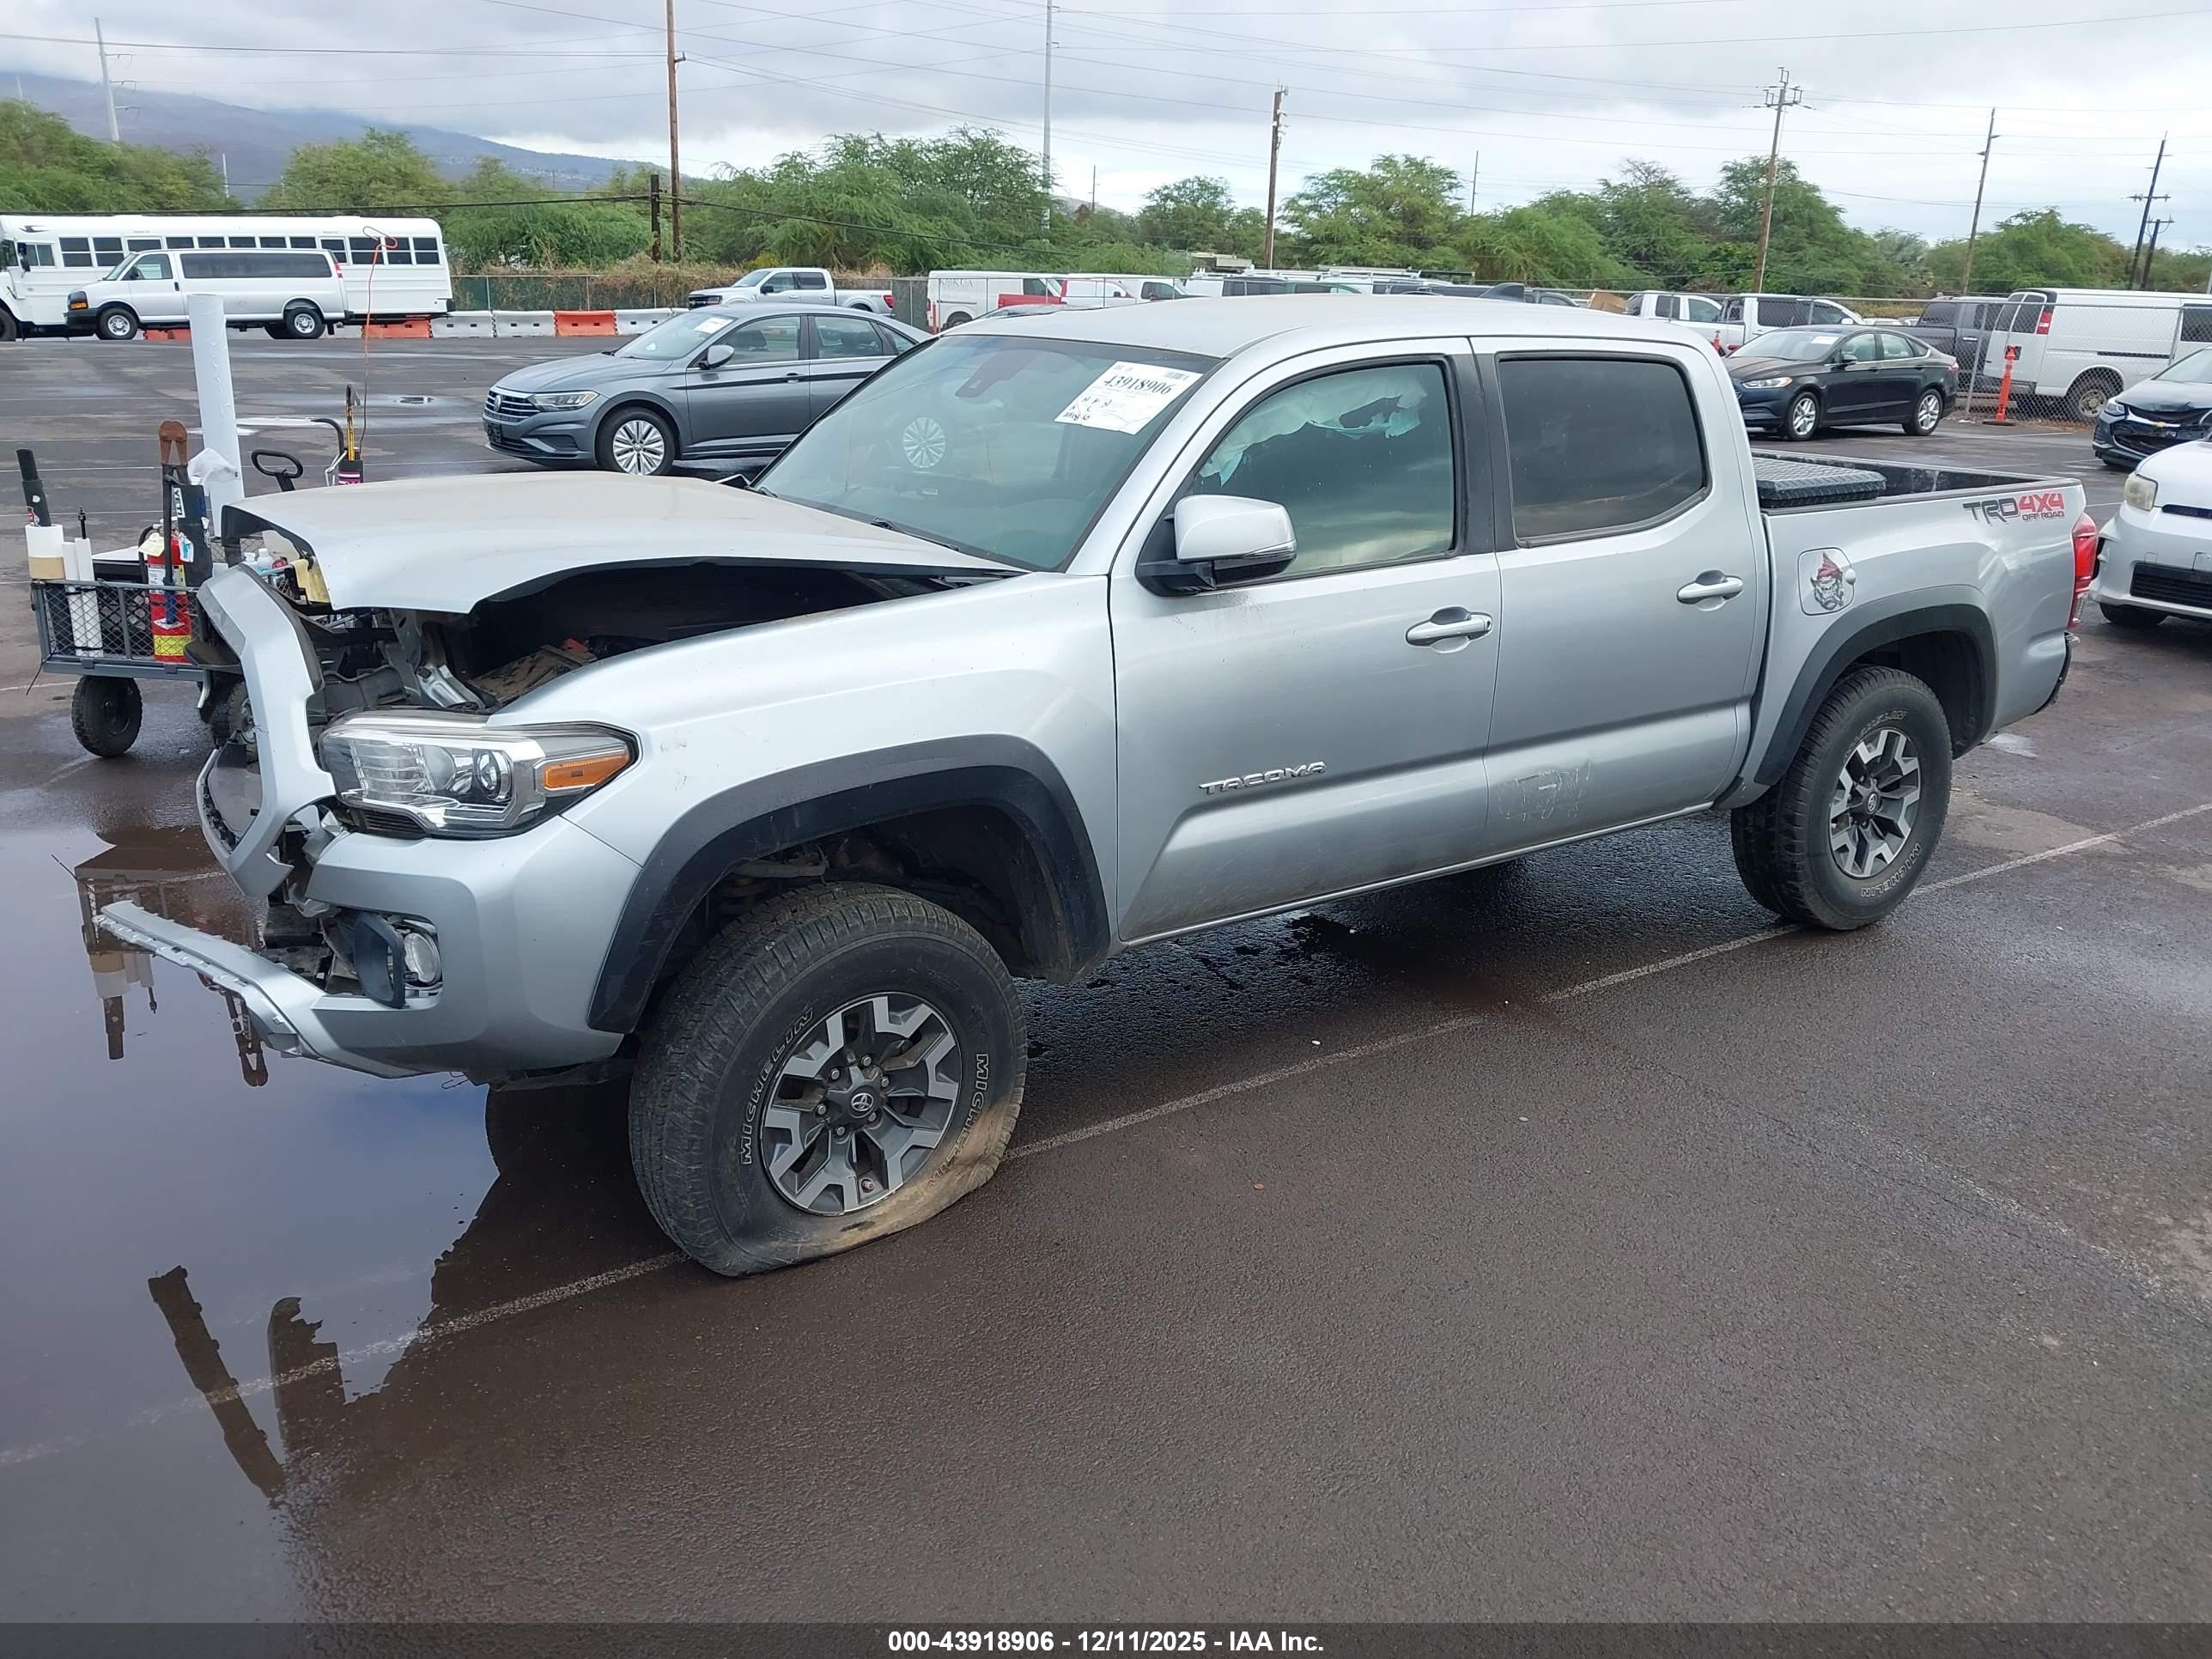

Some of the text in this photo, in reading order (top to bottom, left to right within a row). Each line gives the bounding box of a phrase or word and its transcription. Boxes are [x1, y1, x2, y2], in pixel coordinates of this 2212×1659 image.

[1103, 375, 1176, 394] 43918906
[1962, 497, 2019, 526] TRD
[2021, 510, 2065, 521] OFF ROAD
[1198, 761, 1327, 796] TACOMA
[1861, 842, 1923, 897] MICHELIN
[740, 1007, 813, 1164] MICHELIN
[923, 1053, 989, 1192] MICHELIN
